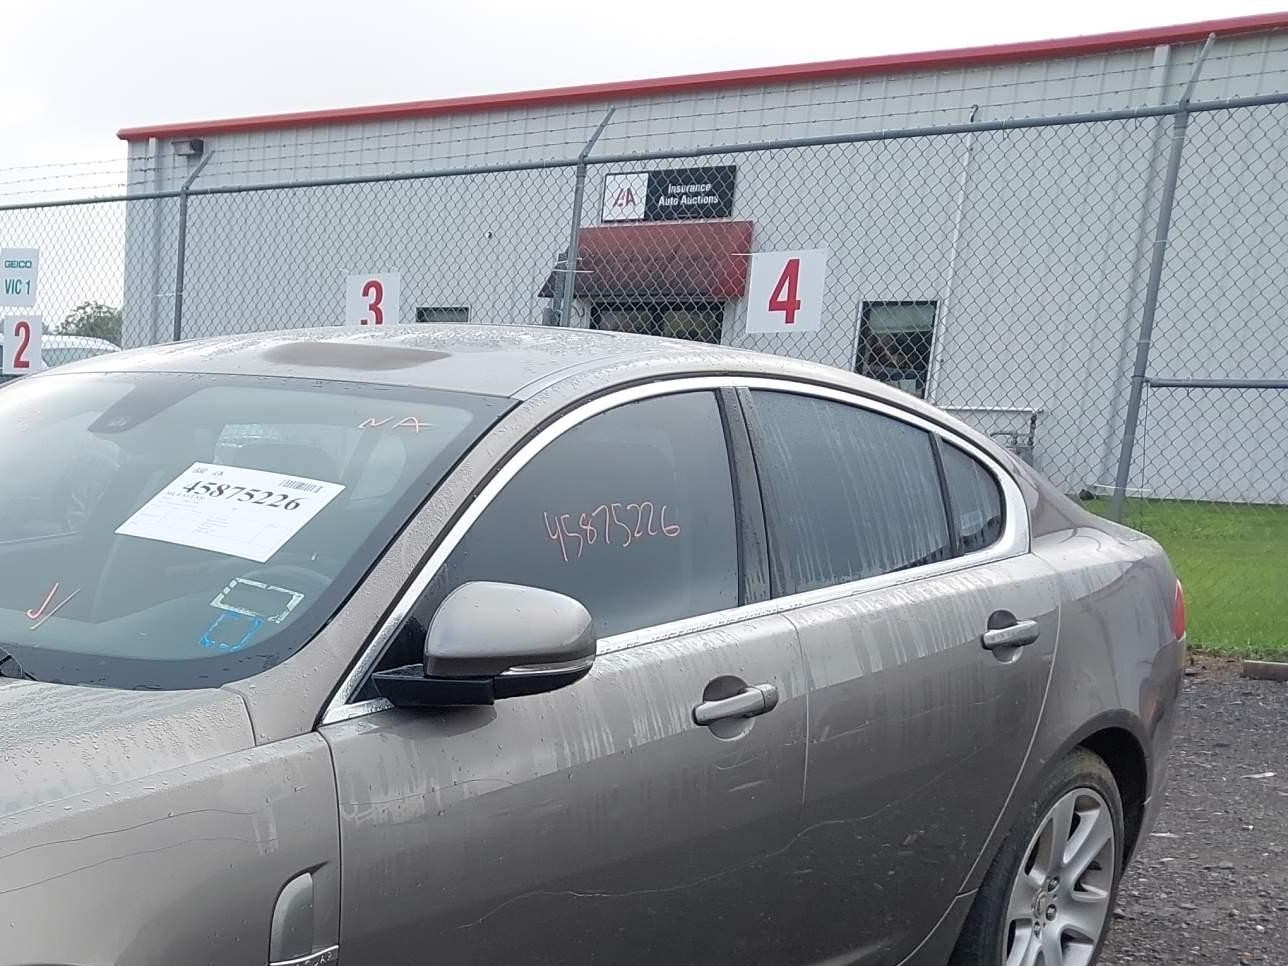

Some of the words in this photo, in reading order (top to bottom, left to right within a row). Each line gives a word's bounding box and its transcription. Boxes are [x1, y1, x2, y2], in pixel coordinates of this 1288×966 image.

[658, 196, 678, 207] Auto
[680, 194, 719, 206] Auctions
[668, 183, 713, 194] Insurance
[4, 260, 32, 269] GEICO
[4, 278, 22, 295] VIC
[25, 279, 31, 295] 1
[768, 257, 801, 325] 4
[360, 280, 384, 326] 3
[13, 320, 31, 369] 2
[182, 480, 309, 511] 45875226
[543, 501, 681, 562] 45875226
